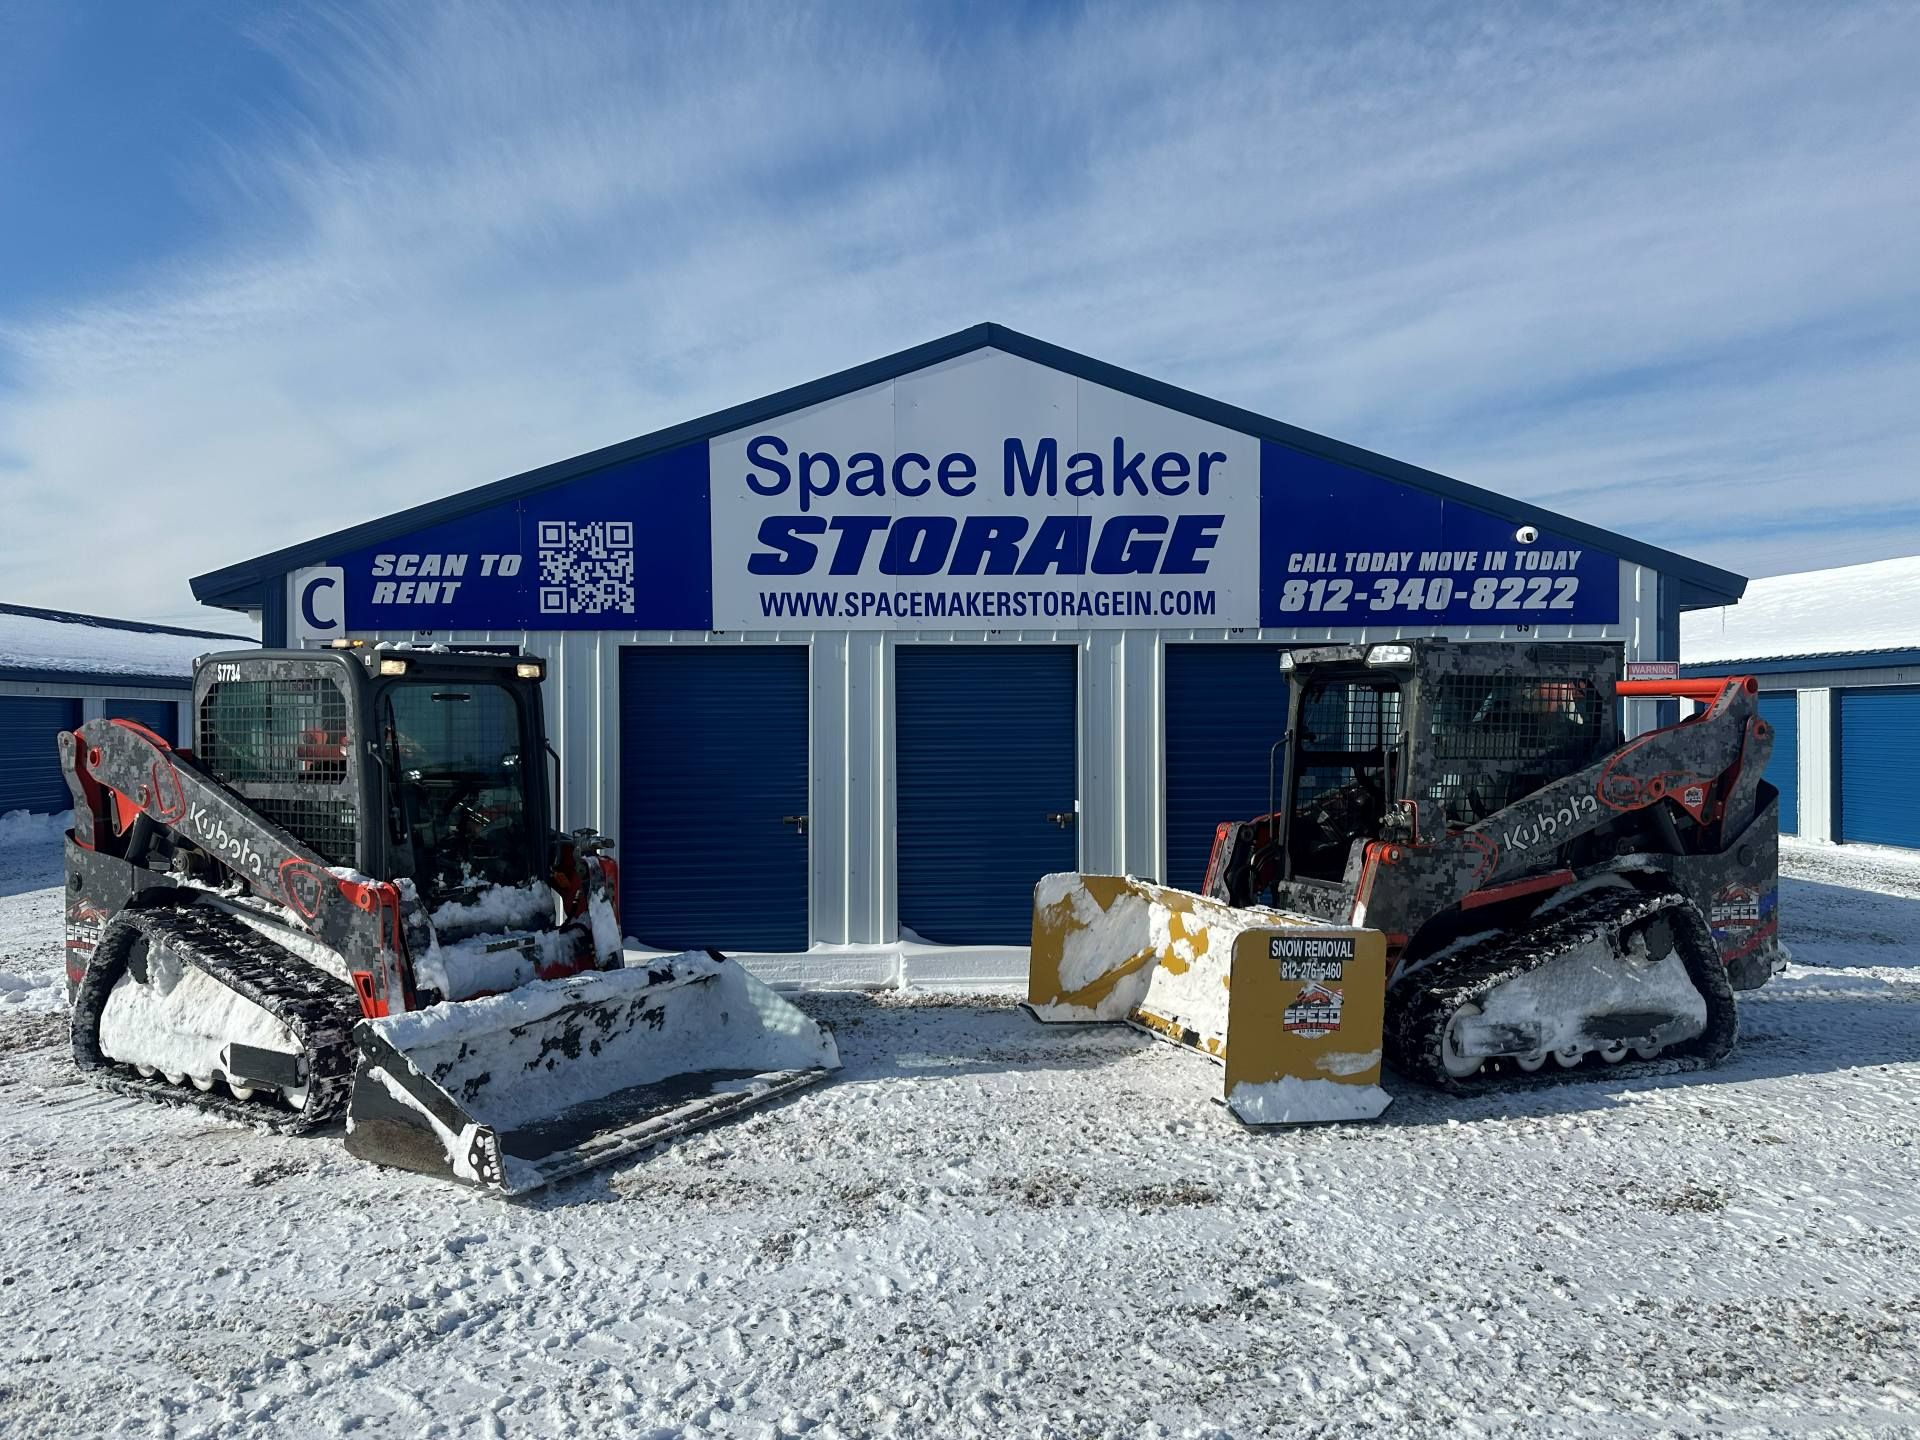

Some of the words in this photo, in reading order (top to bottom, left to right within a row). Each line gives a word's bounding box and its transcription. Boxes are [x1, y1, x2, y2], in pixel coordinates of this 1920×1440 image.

[746, 435, 977, 512] Space
[1003, 436, 1227, 497] Maker
[747, 514, 1225, 576] STORAGE
[371, 554, 469, 577] SCAN
[480, 554, 522, 577] TO
[1287, 552, 1337, 573] CALL
[1344, 551, 1413, 572] TODAY
[1418, 551, 1478, 572] MOVE
[1483, 551, 1508, 571] IN
[1514, 550, 1582, 571] TODAY
[301, 577, 338, 630] C
[371, 581, 462, 604] RENT
[760, 590, 1216, 617] WWW.SPACEMAKERSTORAGEIN.COM
[1279, 577, 1580, 612] 812-340-8222
[217, 663, 241, 682] S7734
[1631, 665, 1675, 674] WARNING
[1503, 795, 1598, 850] Kubota
[189, 801, 262, 876] Kubota
[1711, 905, 1760, 921] SPEED
[66, 924, 99, 944] SPEE
[1272, 940, 1303, 957] SNOW
[1305, 941, 1354, 958] REMOVAL
[1281, 962, 1342, 979] 812-276-5460
[1284, 1008, 1341, 1024] SPEED
